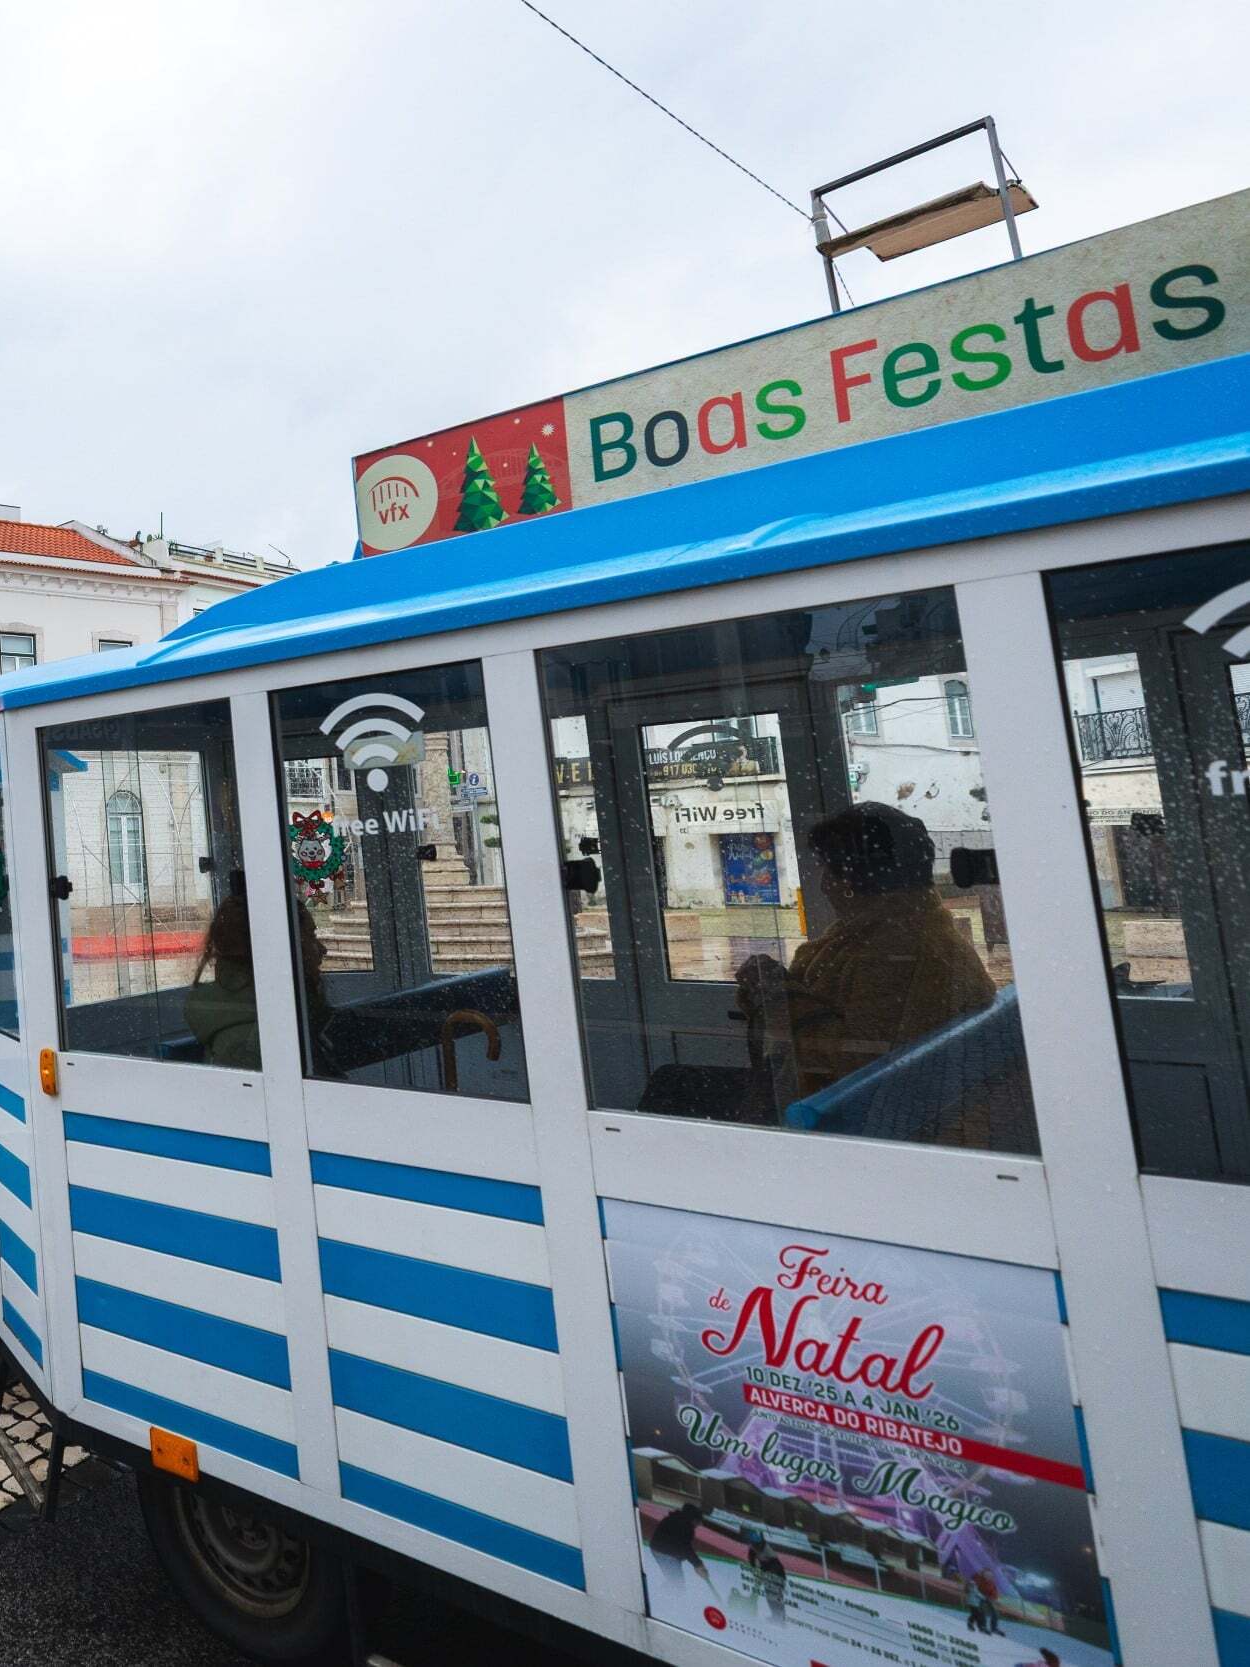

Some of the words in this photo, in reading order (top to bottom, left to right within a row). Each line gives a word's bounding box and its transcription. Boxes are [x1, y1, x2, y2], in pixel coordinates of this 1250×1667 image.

[589, 379, 807, 483] Boas
[829, 263, 1228, 424] Festas
[378, 503, 410, 525] vfx
[709, 1287, 732, 1311] de
[777, 1245, 889, 1305] Feira
[701, 1286, 945, 1400] Natal
[746, 1366, 764, 1383] 10
[843, 1389, 857, 1407] A
[862, 1394, 874, 1411] 4
[750, 1387, 831, 1421] ALVERCA
[833, 1407, 860, 1430] DO
[864, 1416, 963, 1456] RIBATEJO
[678, 1405, 751, 1458] Um
[760, 1431, 841, 1484] lugar
[855, 1461, 1016, 1534] Mágico
